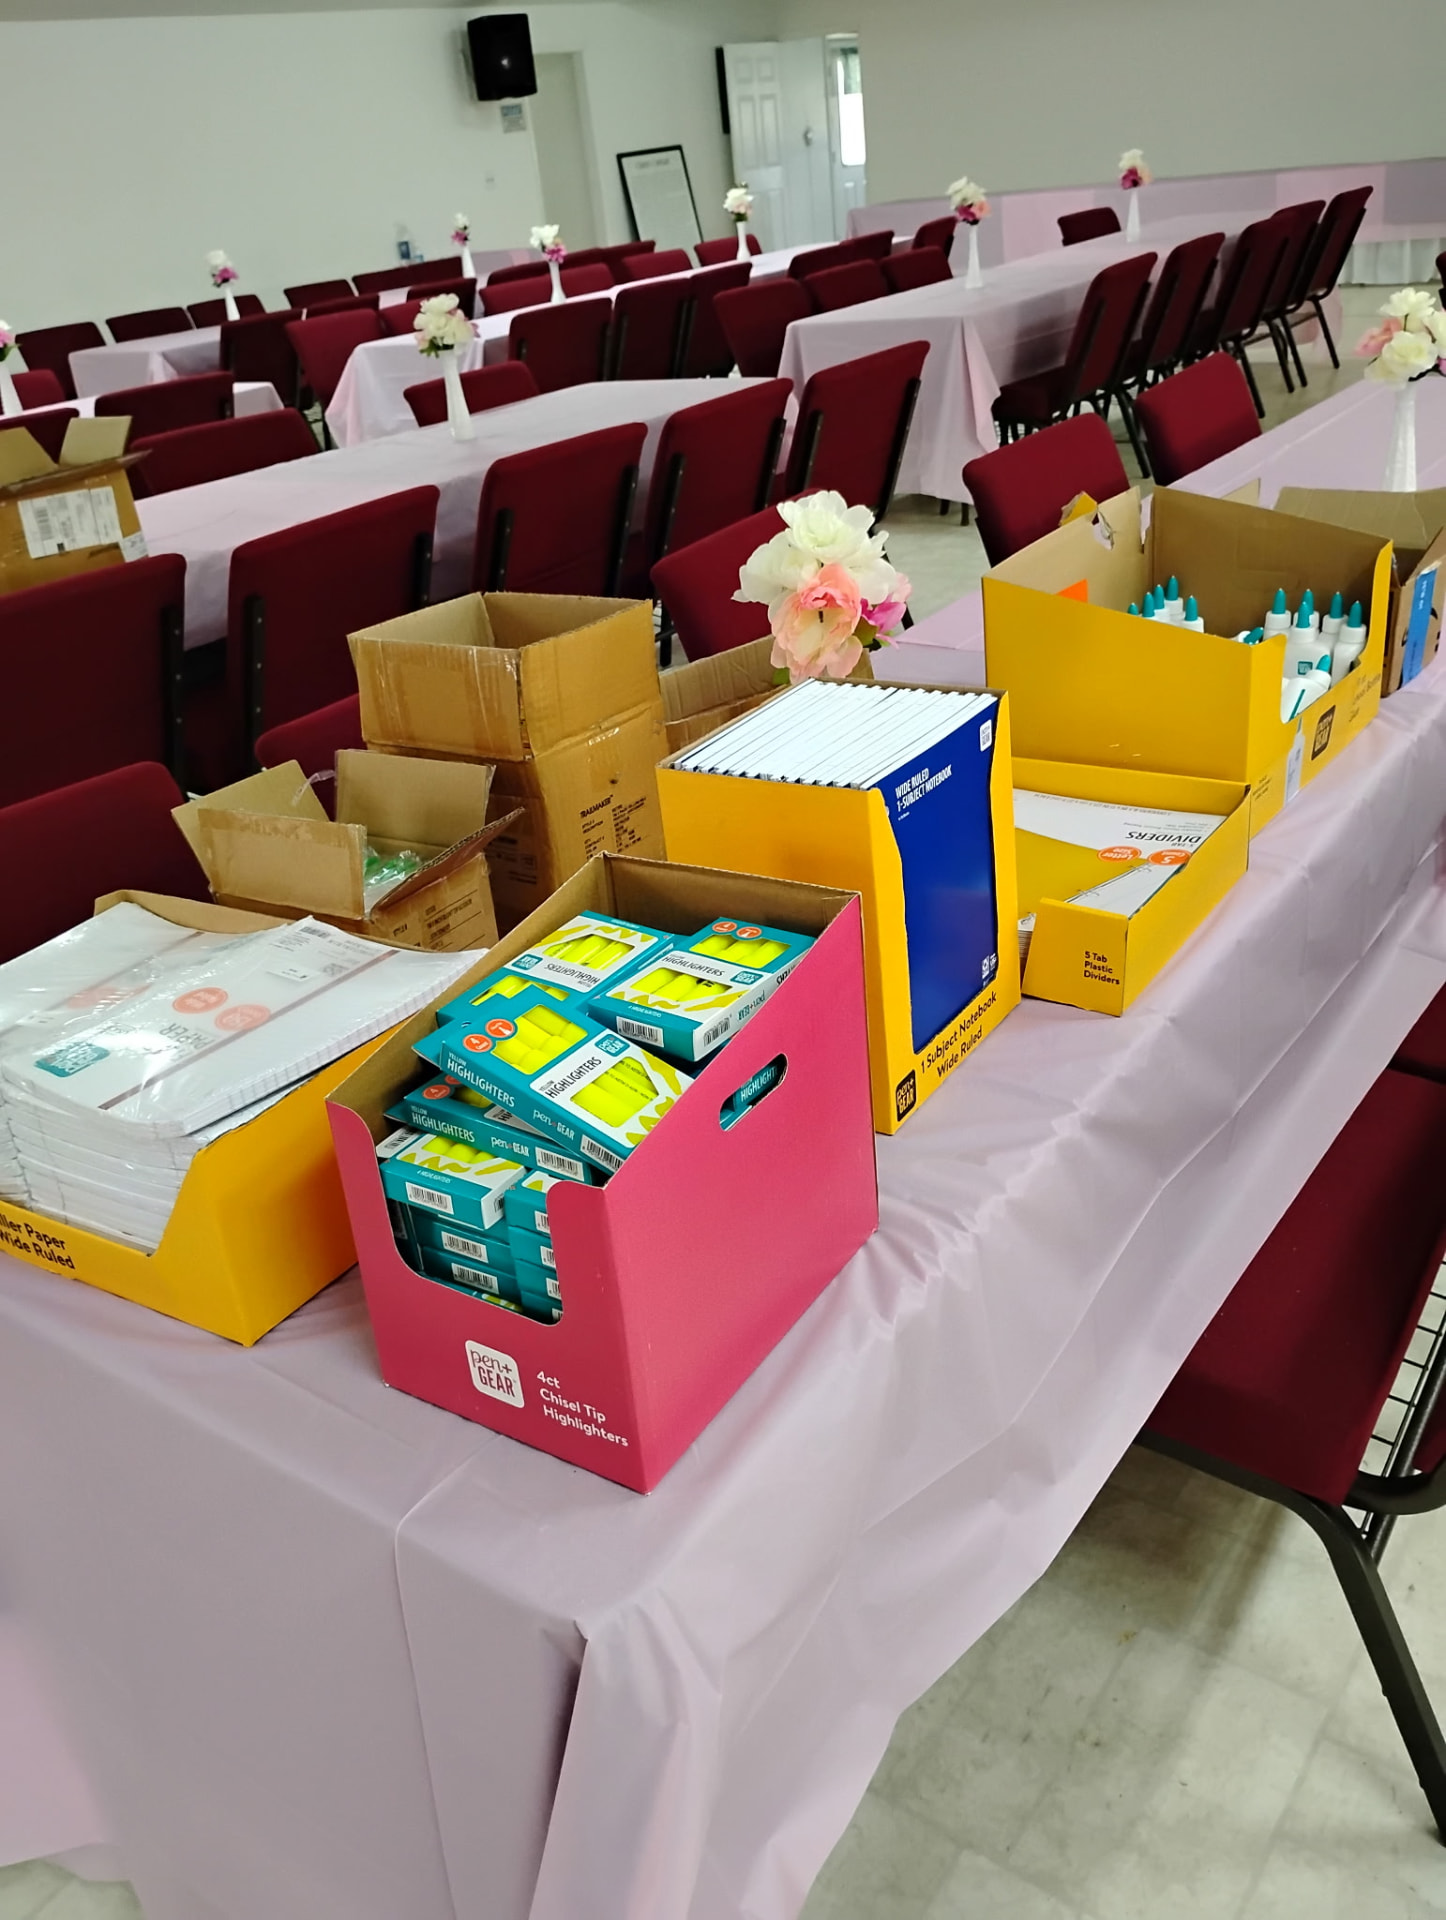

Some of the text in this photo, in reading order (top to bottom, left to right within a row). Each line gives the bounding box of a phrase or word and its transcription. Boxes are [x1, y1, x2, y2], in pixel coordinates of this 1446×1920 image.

[895, 768, 929, 799] WIDE RULED
[897, 764, 952, 812] 1-SUBJECT NOTEBOOK
[1125, 831, 1202, 843] DIVIDERS
[1102, 852, 1133, 861] Letter
[1161, 855, 1175, 864] 5
[662, 956, 725, 977] HIGHLIGHTERS
[1084, 950, 1108, 963] 5 Tab
[1084, 960, 1113, 974] Plastic
[545, 962, 601, 984] HIGHLIGHTERS
[1083, 970, 1120, 985] Dividers
[921, 991, 997, 1074] 1 Subject Notebook
[937, 1025, 983, 1077] Wide Ruled
[447, 1058, 515, 1108] HIGHLIGHTERS
[545, 1056, 602, 1099] HIGHLIGHTERS
[411, 1112, 475, 1143] HIGHLIGHTERS
[23, 1222, 66, 1251] Paper
[32, 1241, 76, 1270] Ruled
[470, 1349, 513, 1375] pen+
[478, 1365, 516, 1398] GEAR
[536, 1370, 561, 1389] 4ct
[539, 1388, 607, 1424] Chisel Tip
[543, 1404, 629, 1448] Highlighters
